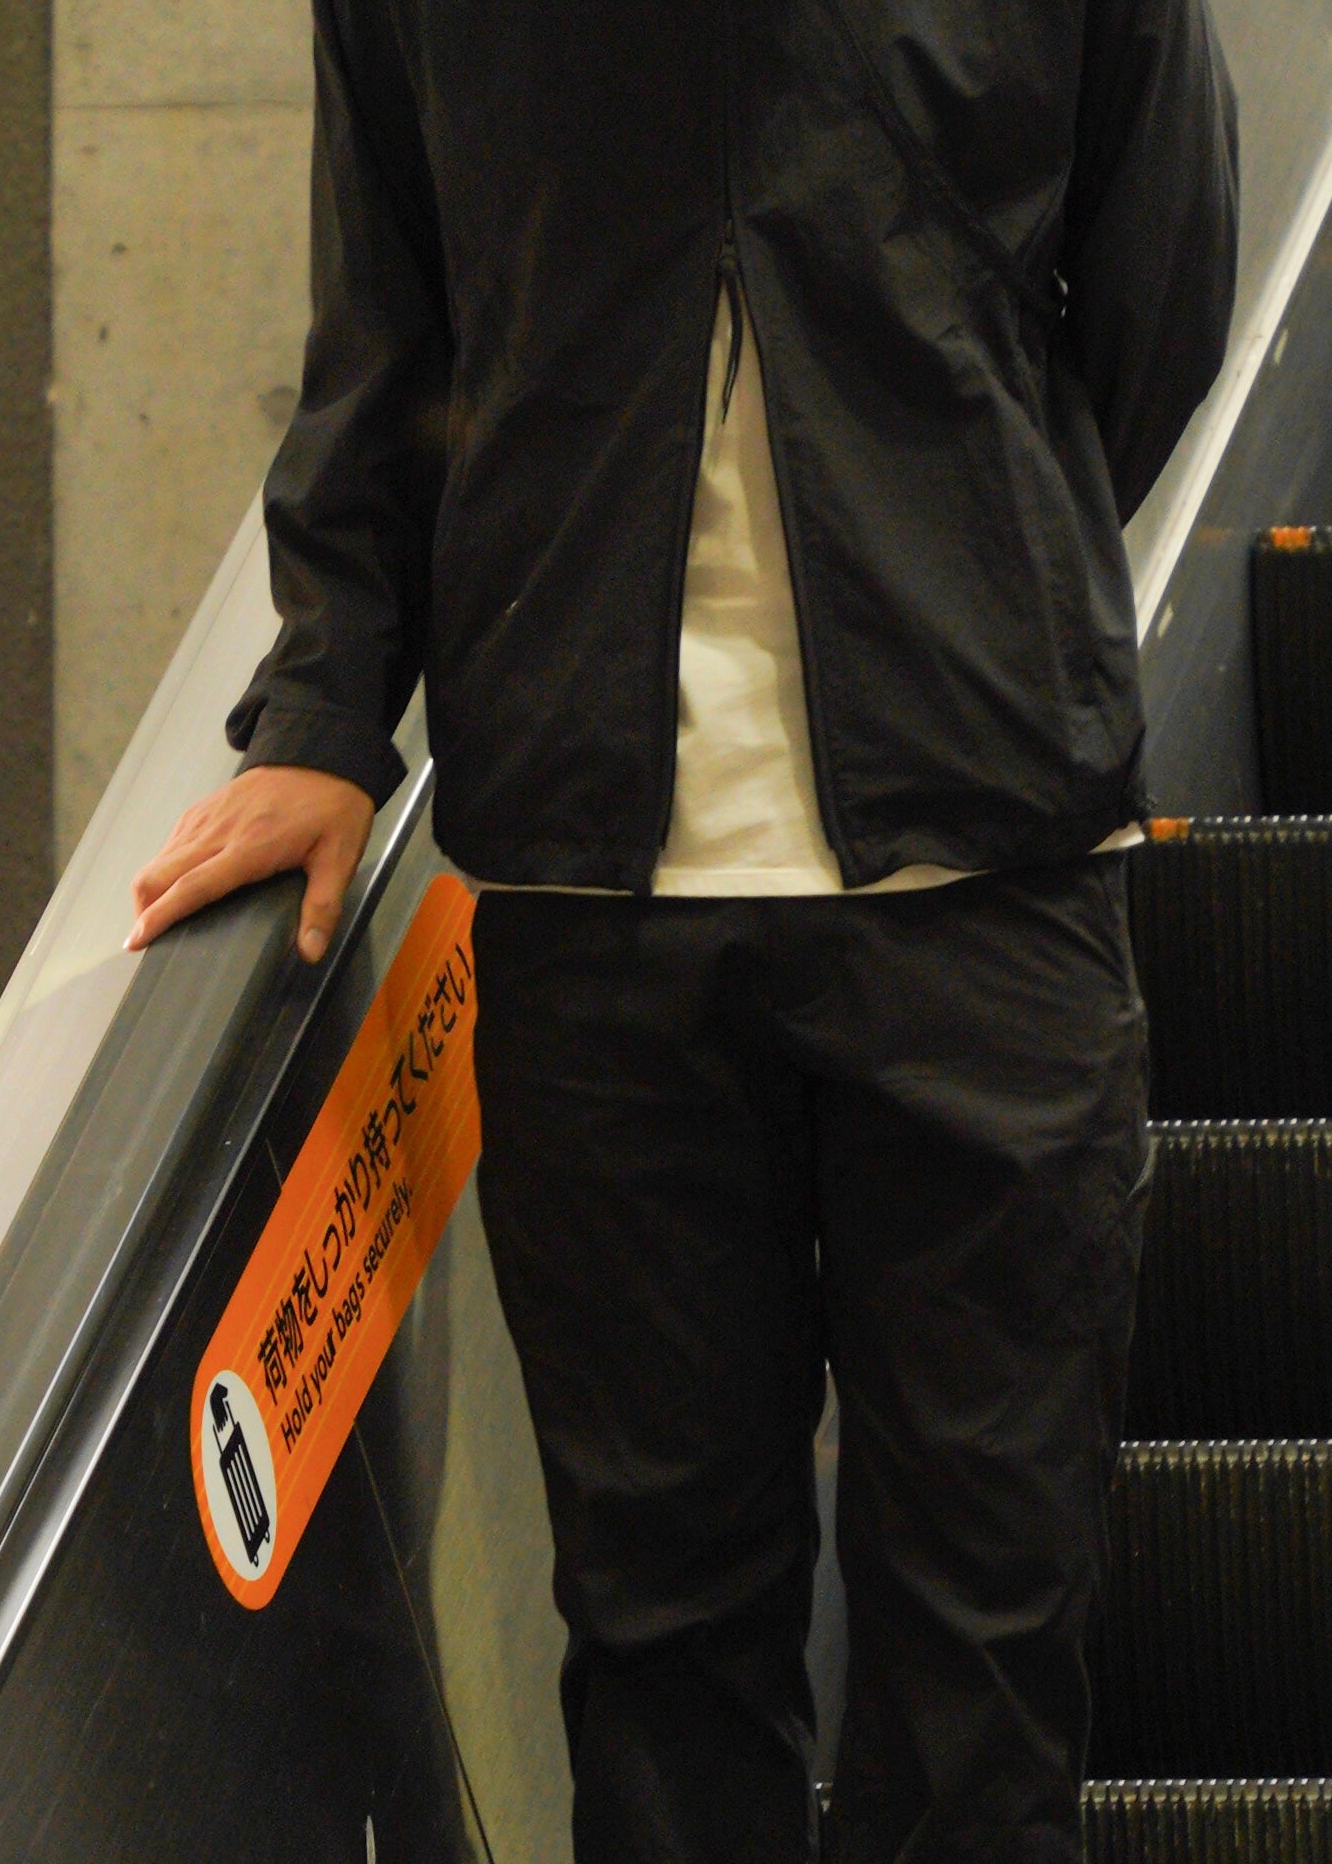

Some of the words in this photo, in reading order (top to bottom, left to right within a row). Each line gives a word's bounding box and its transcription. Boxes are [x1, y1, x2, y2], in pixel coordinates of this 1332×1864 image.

[257, 942, 472, 1406] 荷物をしっかり持ってください
[280, 1375, 314, 1455] Hold
[309, 1327, 338, 1406] your
[331, 1271, 366, 1340] bags
[362, 1176, 414, 1283] securely.
